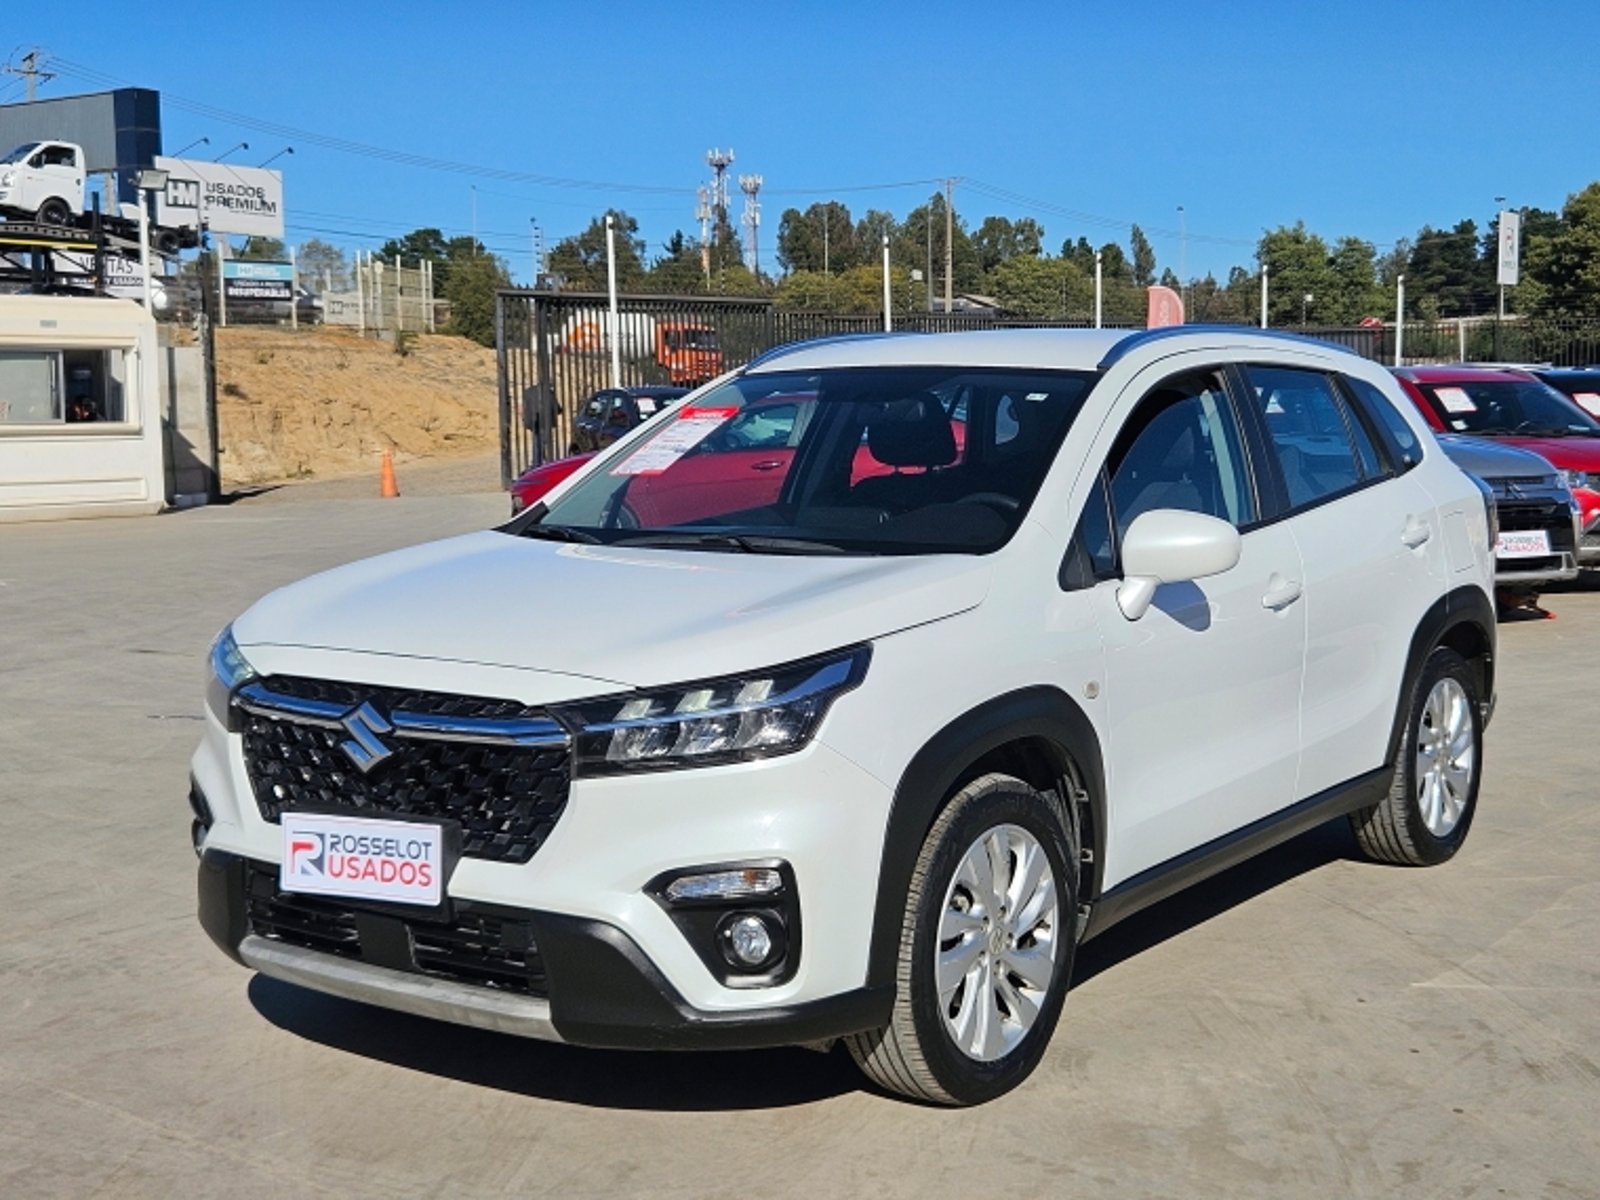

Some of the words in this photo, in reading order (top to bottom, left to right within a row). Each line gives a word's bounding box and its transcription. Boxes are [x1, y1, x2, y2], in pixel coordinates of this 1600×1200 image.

[205, 181, 266, 199] USADOS
[205, 195, 277, 213] PREMIUM
[329, 834, 433, 861] ROSSELOT
[328, 855, 433, 888] USADOS
